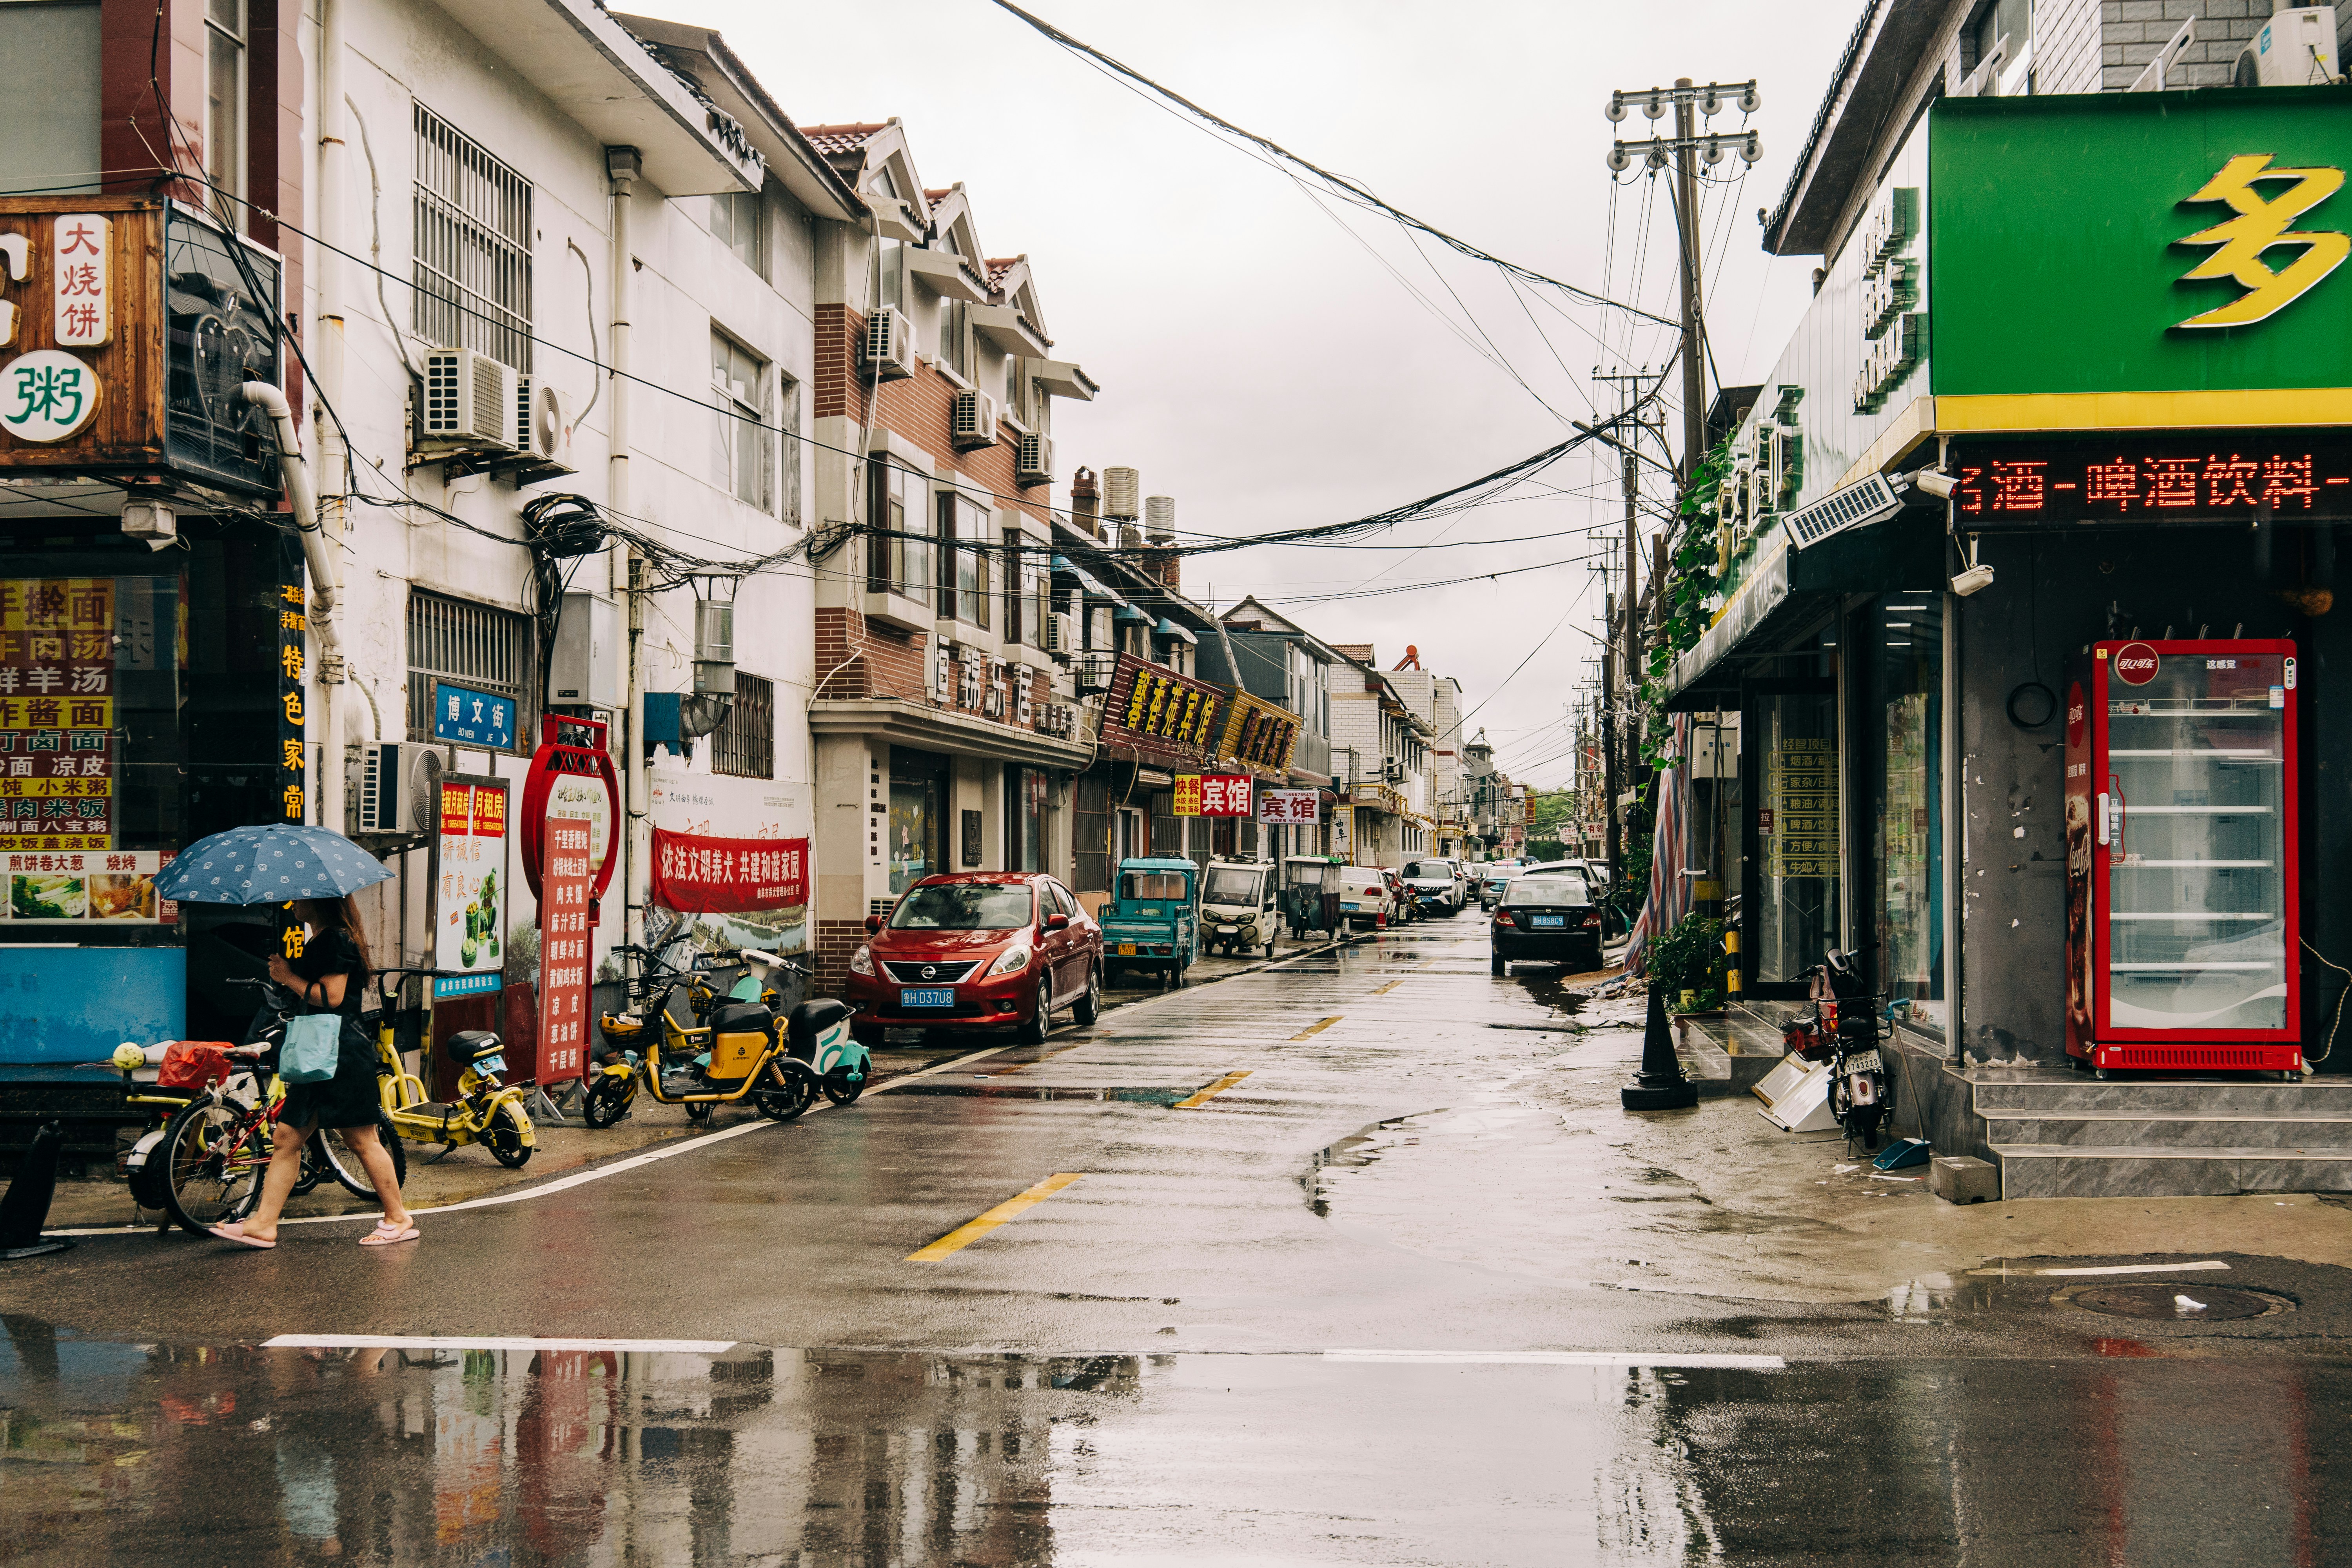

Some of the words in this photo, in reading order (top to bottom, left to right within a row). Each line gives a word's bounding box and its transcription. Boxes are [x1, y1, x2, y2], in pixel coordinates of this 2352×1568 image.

[2176, 154, 2352, 328] 多
[60, 222, 102, 338] 大烧饼
[5, 366, 82, 425] 粥
[280, 612, 305, 631] 手擀面
[2119, 658, 2156, 669] 可口可乐
[2207, 660, 2236, 669] 这感觉
[448, 695, 504, 729] 博文街
[1127, 669, 1214, 746] 馨香苑宾馆
[458, 727, 464, 736] BO
[465, 729, 474, 739] WEN
[1783, 738, 1831, 750] 经营项目
[51, 756, 106, 777] 凉皮
[1790, 755, 1840, 766] 烟酒/副食
[37, 779, 107, 795] 小米粥
[1176, 778, 1200, 796] 快餐
[1202, 779, 1249, 813] 宾馆
[282, 645, 305, 958] 特色家常馆
[474, 791, 503, 819] 月租房
[1261, 797, 1316, 818] 宾馆
[1790, 799, 1840, 809] 粮油/调料
[1760, 813, 1770, 822] 拉
[1790, 819, 1840, 831] 啤酒/饮料
[1334, 818, 1348, 844] 曲阜
[1588, 824, 1603, 833] 有邻
[443, 835, 481, 862] 讲诚信
[554, 829, 588, 850] 千里香馄饨
[1790, 841, 1840, 852] 方便/食品
[9, 855, 84, 871] 煎饼卷大葱
[106, 854, 137, 871] 烧烤
[553, 857, 587, 878] 砂锅米线土豆粉
[662, 842, 734, 884] 依法文明养犬
[739, 850, 799, 884] 共建和谐家园
[1790, 862, 1840, 873] 牛奶/雪糕
[441, 869, 481, 900] 有良心
[557, 884, 583, 905] 肉夹馍
[757, 884, 794, 899] 曲阜市养犬管理办公室
[795, 884, 799, 895] 宣
[552, 912, 585, 933] 麻汁凉面
[550, 940, 584, 961] 朝鲜冷面
[441, 976, 493, 992] 曲阜市民政局设立
[549, 966, 583, 989] 黄焖鸡米饭
[551, 1021, 577, 1044] 葱油饼
[550, 1048, 577, 1073] 千层饼
[1847, 1058, 1878, 1071] 1743223
